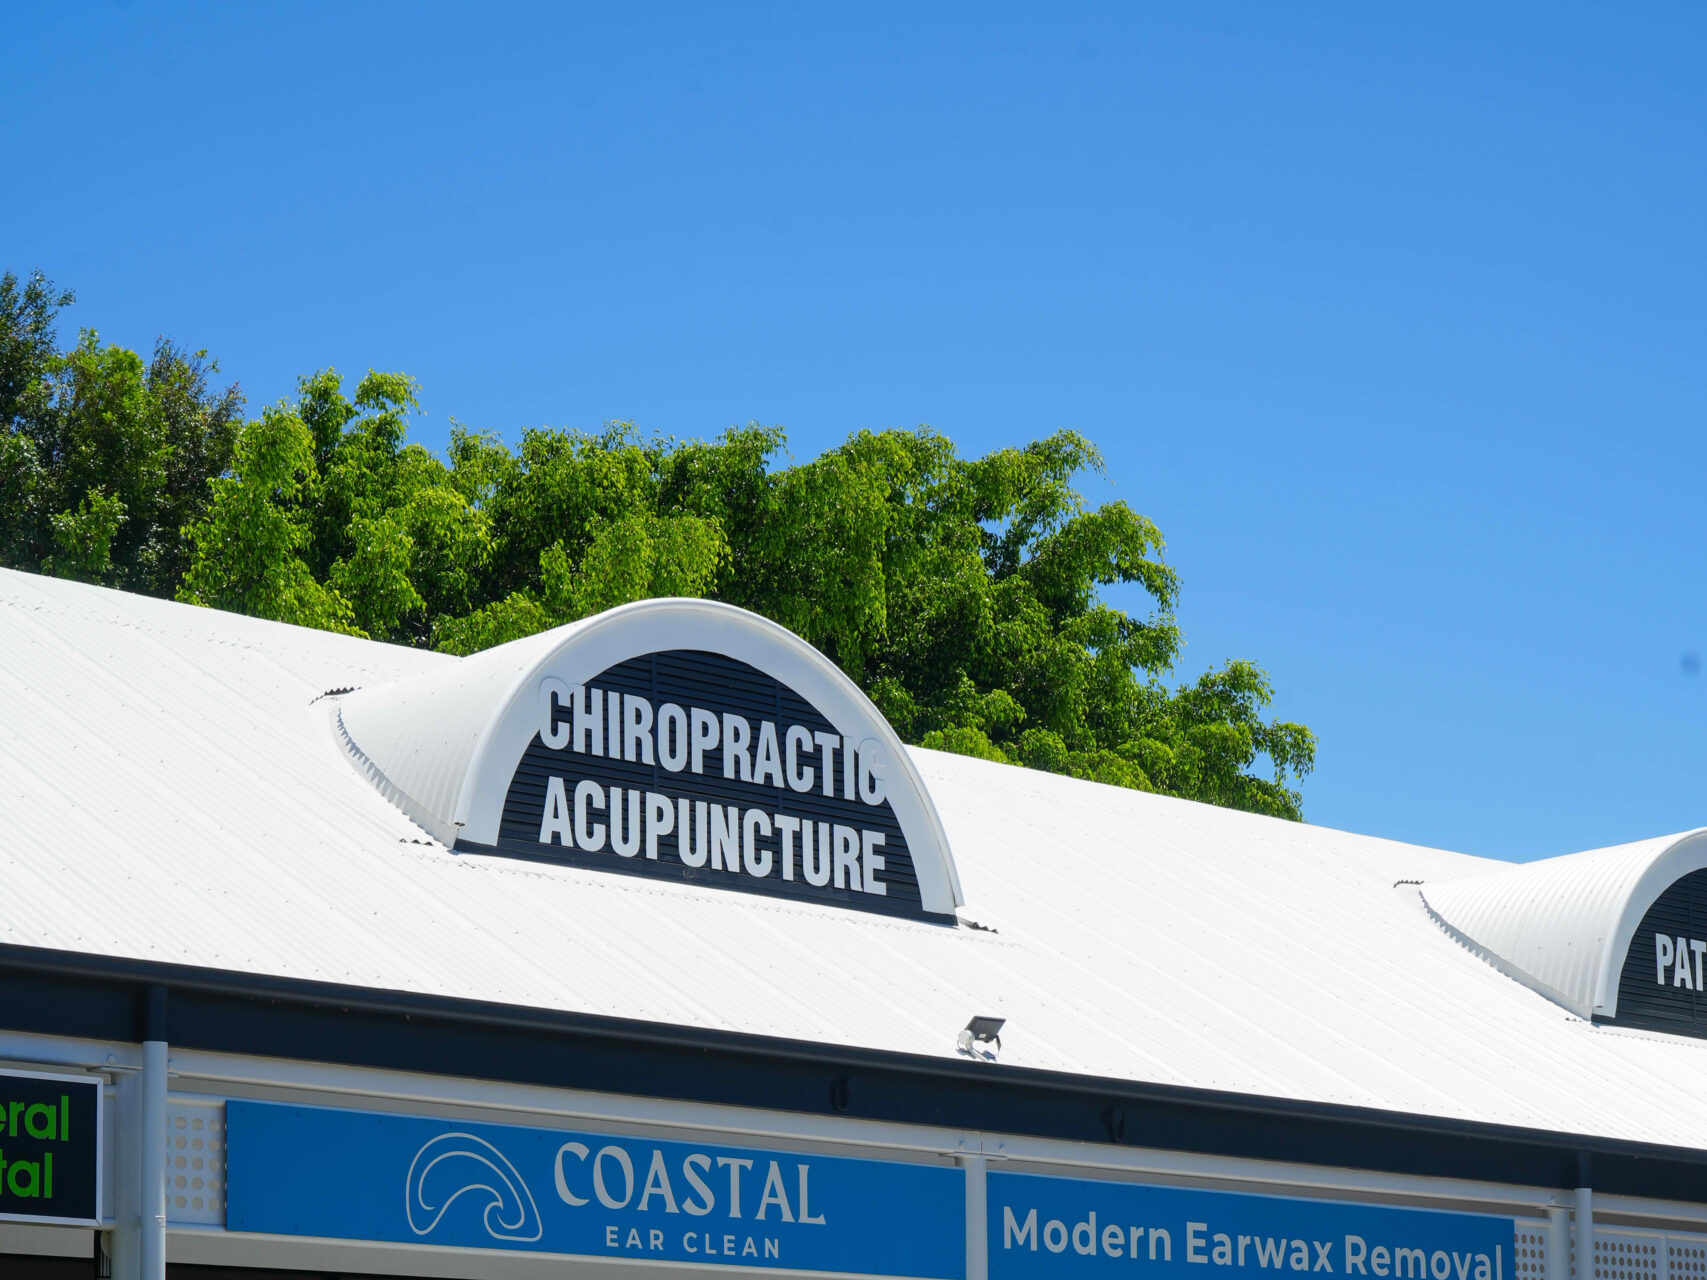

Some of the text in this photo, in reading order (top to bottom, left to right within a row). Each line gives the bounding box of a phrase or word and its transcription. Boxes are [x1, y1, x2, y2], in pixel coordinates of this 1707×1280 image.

[538, 676, 888, 805] CHIROPRACTIC
[538, 775, 887, 896] ACUPUNCTURE
[554, 1141, 827, 1225] COASTAL
[605, 1225, 780, 1259] EAR CLEAN
[1002, 1206, 1172, 1262] Modern
[1185, 1221, 1334, 1273] Earwax
